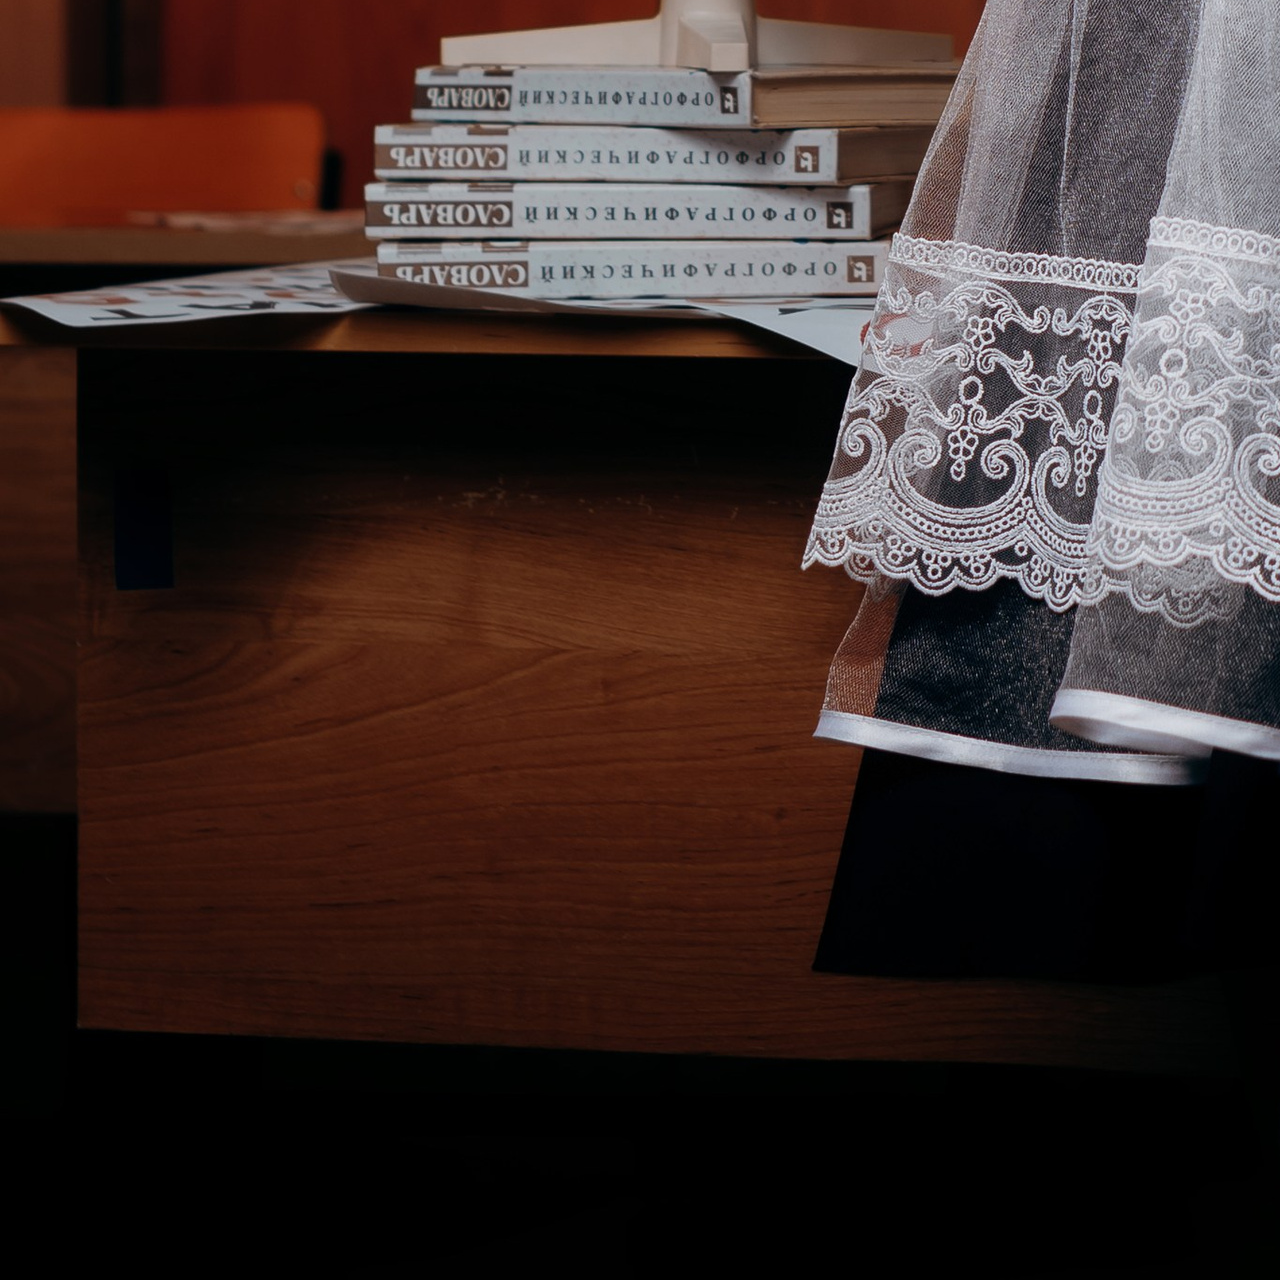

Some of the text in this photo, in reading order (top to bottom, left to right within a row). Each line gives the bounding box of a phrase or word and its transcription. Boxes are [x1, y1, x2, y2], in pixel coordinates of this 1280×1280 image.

[426, 86, 715, 110] ОРФОГРАФИЧЕСКИЙ СЛОВАРЬ
[389, 145, 786, 169] ОРФОГРАФИЧЕСКИЙ СЛОВАРЬ
[382, 203, 818, 227] ОРФОГРАФИЧЕСКИЙ СЛОВАРЬ
[395, 260, 838, 287] ОРФОГРАФИЧЕСКИЙ СЛОВАРЬ
